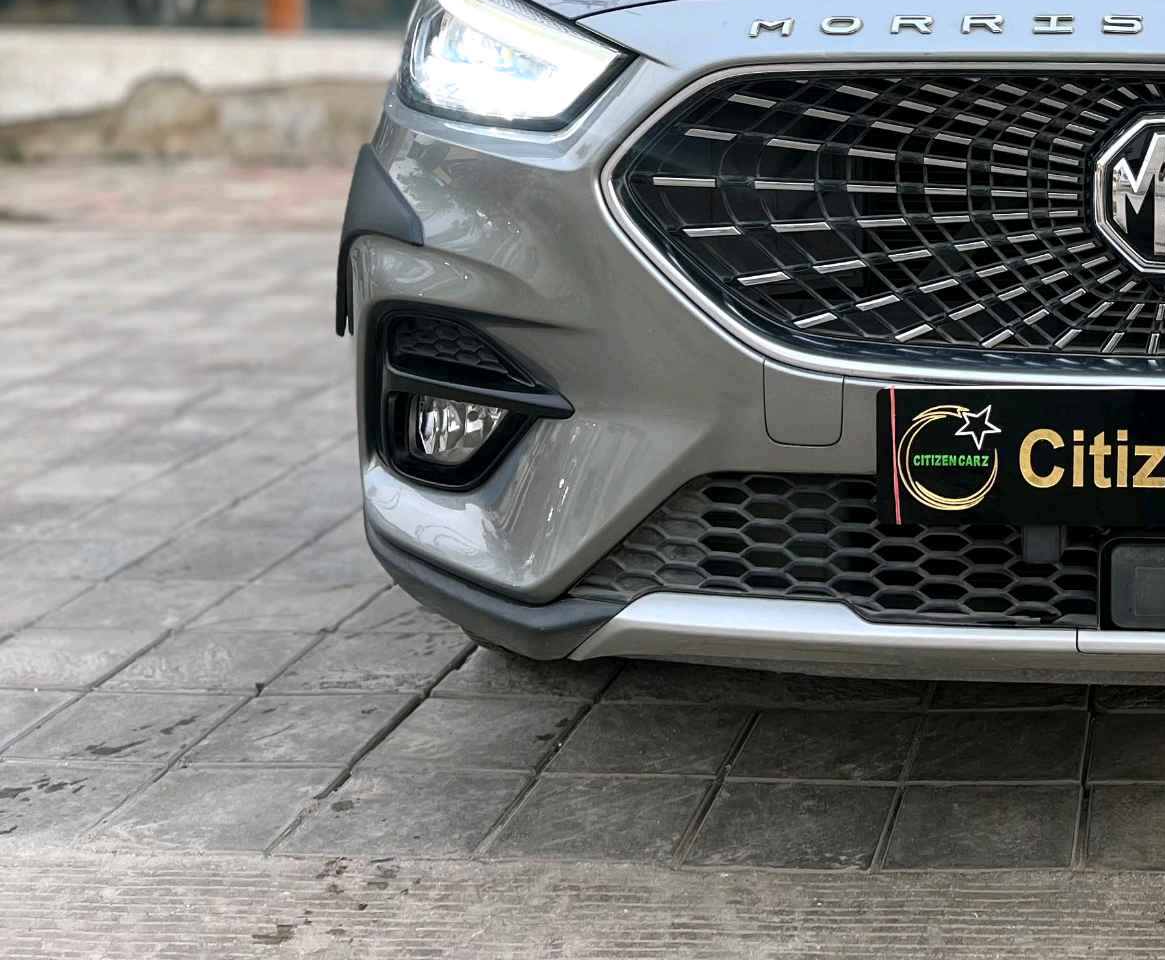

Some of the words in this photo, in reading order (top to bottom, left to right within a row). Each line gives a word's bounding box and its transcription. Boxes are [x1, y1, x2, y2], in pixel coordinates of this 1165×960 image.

[748, 14, 1145, 38] MORRIS
[913, 454, 957, 466] CITIZEN
[958, 455, 990, 467] CARZ
